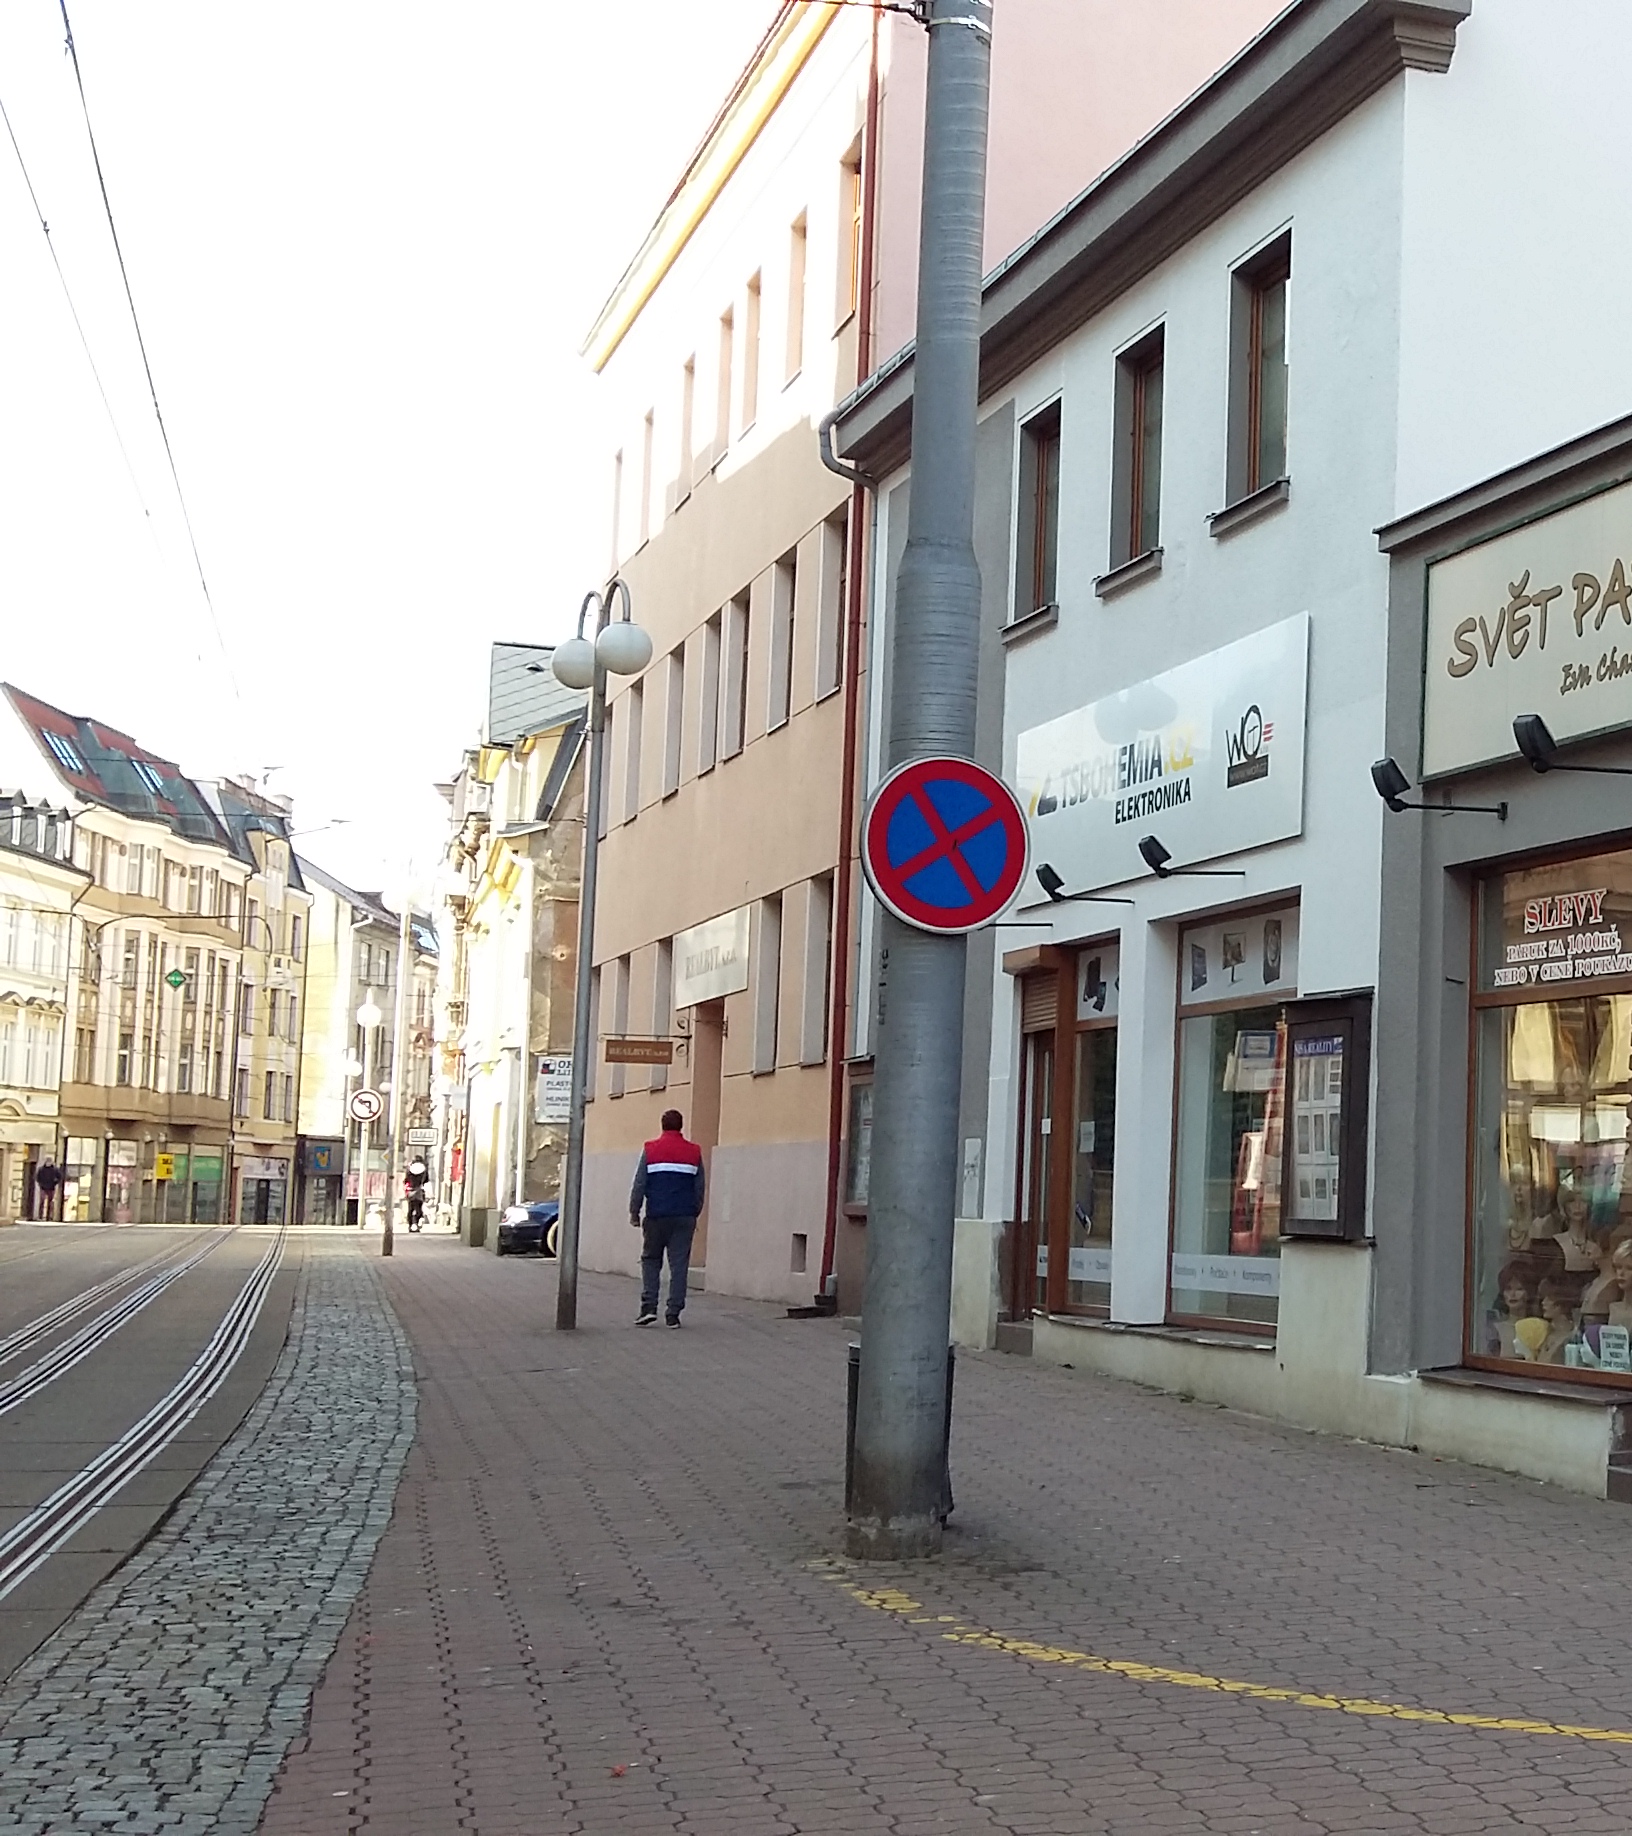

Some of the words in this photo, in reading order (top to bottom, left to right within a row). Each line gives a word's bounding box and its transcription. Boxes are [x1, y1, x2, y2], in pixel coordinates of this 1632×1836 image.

[1447, 569, 1562, 678] SVĚT
[1115, 777, 1192, 825] ELEKTRONIKA
[1524, 888, 1607, 934] SLEVY
[1507, 940, 1547, 963] PARUK
[1549, 939, 1565, 957] ZA
[1494, 967, 1527, 986] NEBO
[1529, 967, 1539, 982] V
